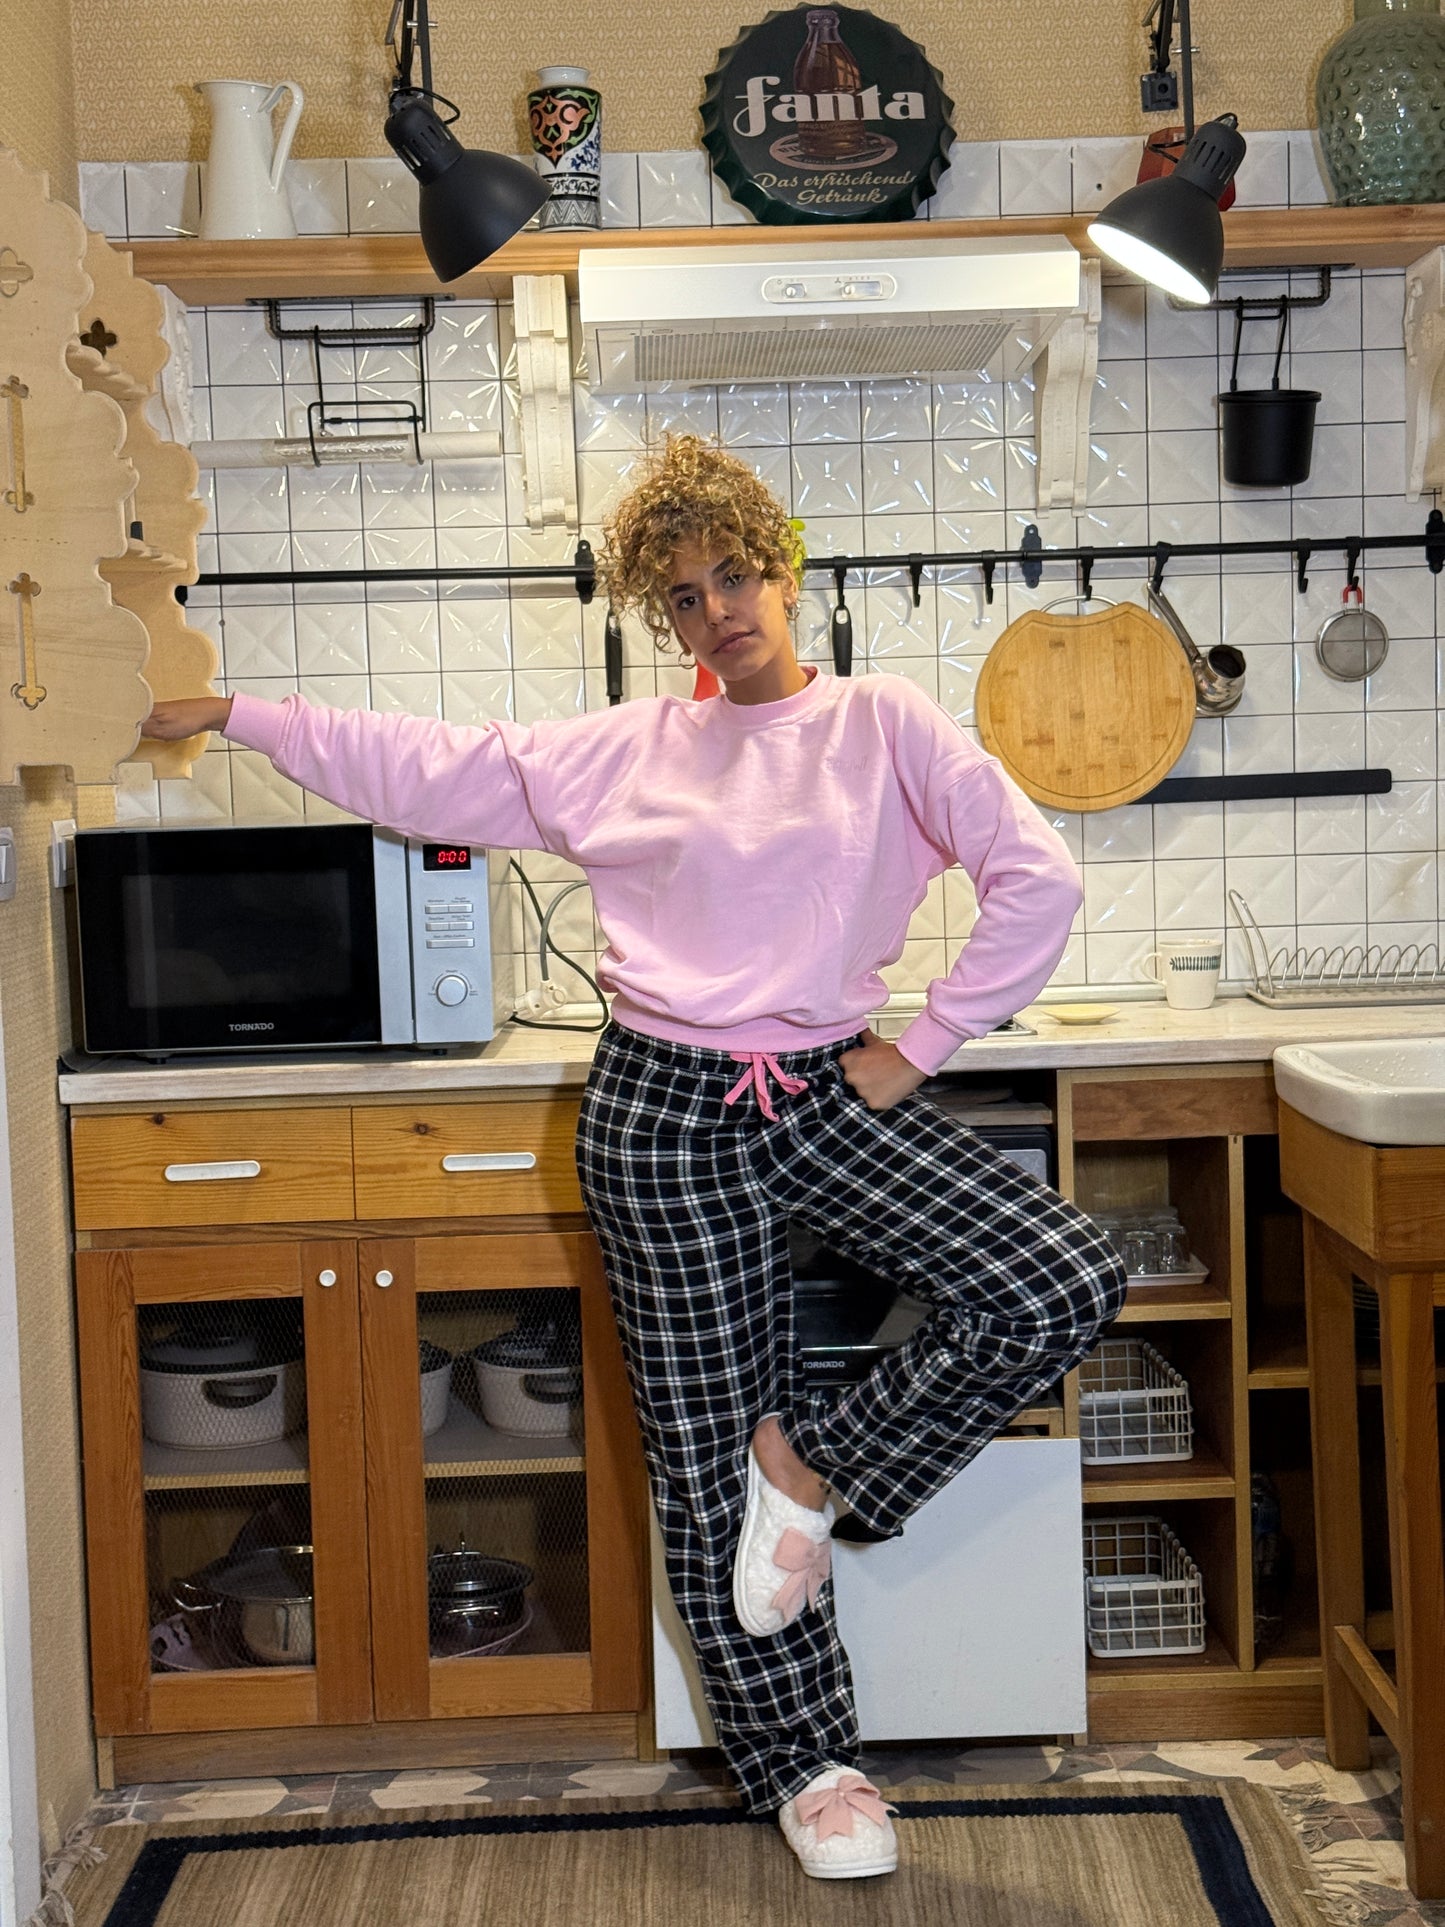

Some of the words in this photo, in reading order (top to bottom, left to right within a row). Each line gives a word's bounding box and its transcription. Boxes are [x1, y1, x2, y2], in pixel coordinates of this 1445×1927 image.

[753, 172, 798, 188] Das
[438, 850, 467, 863] 0:00
[228, 1022, 275, 1032] TORNADO
[802, 1361, 845, 1369] TORNADO
